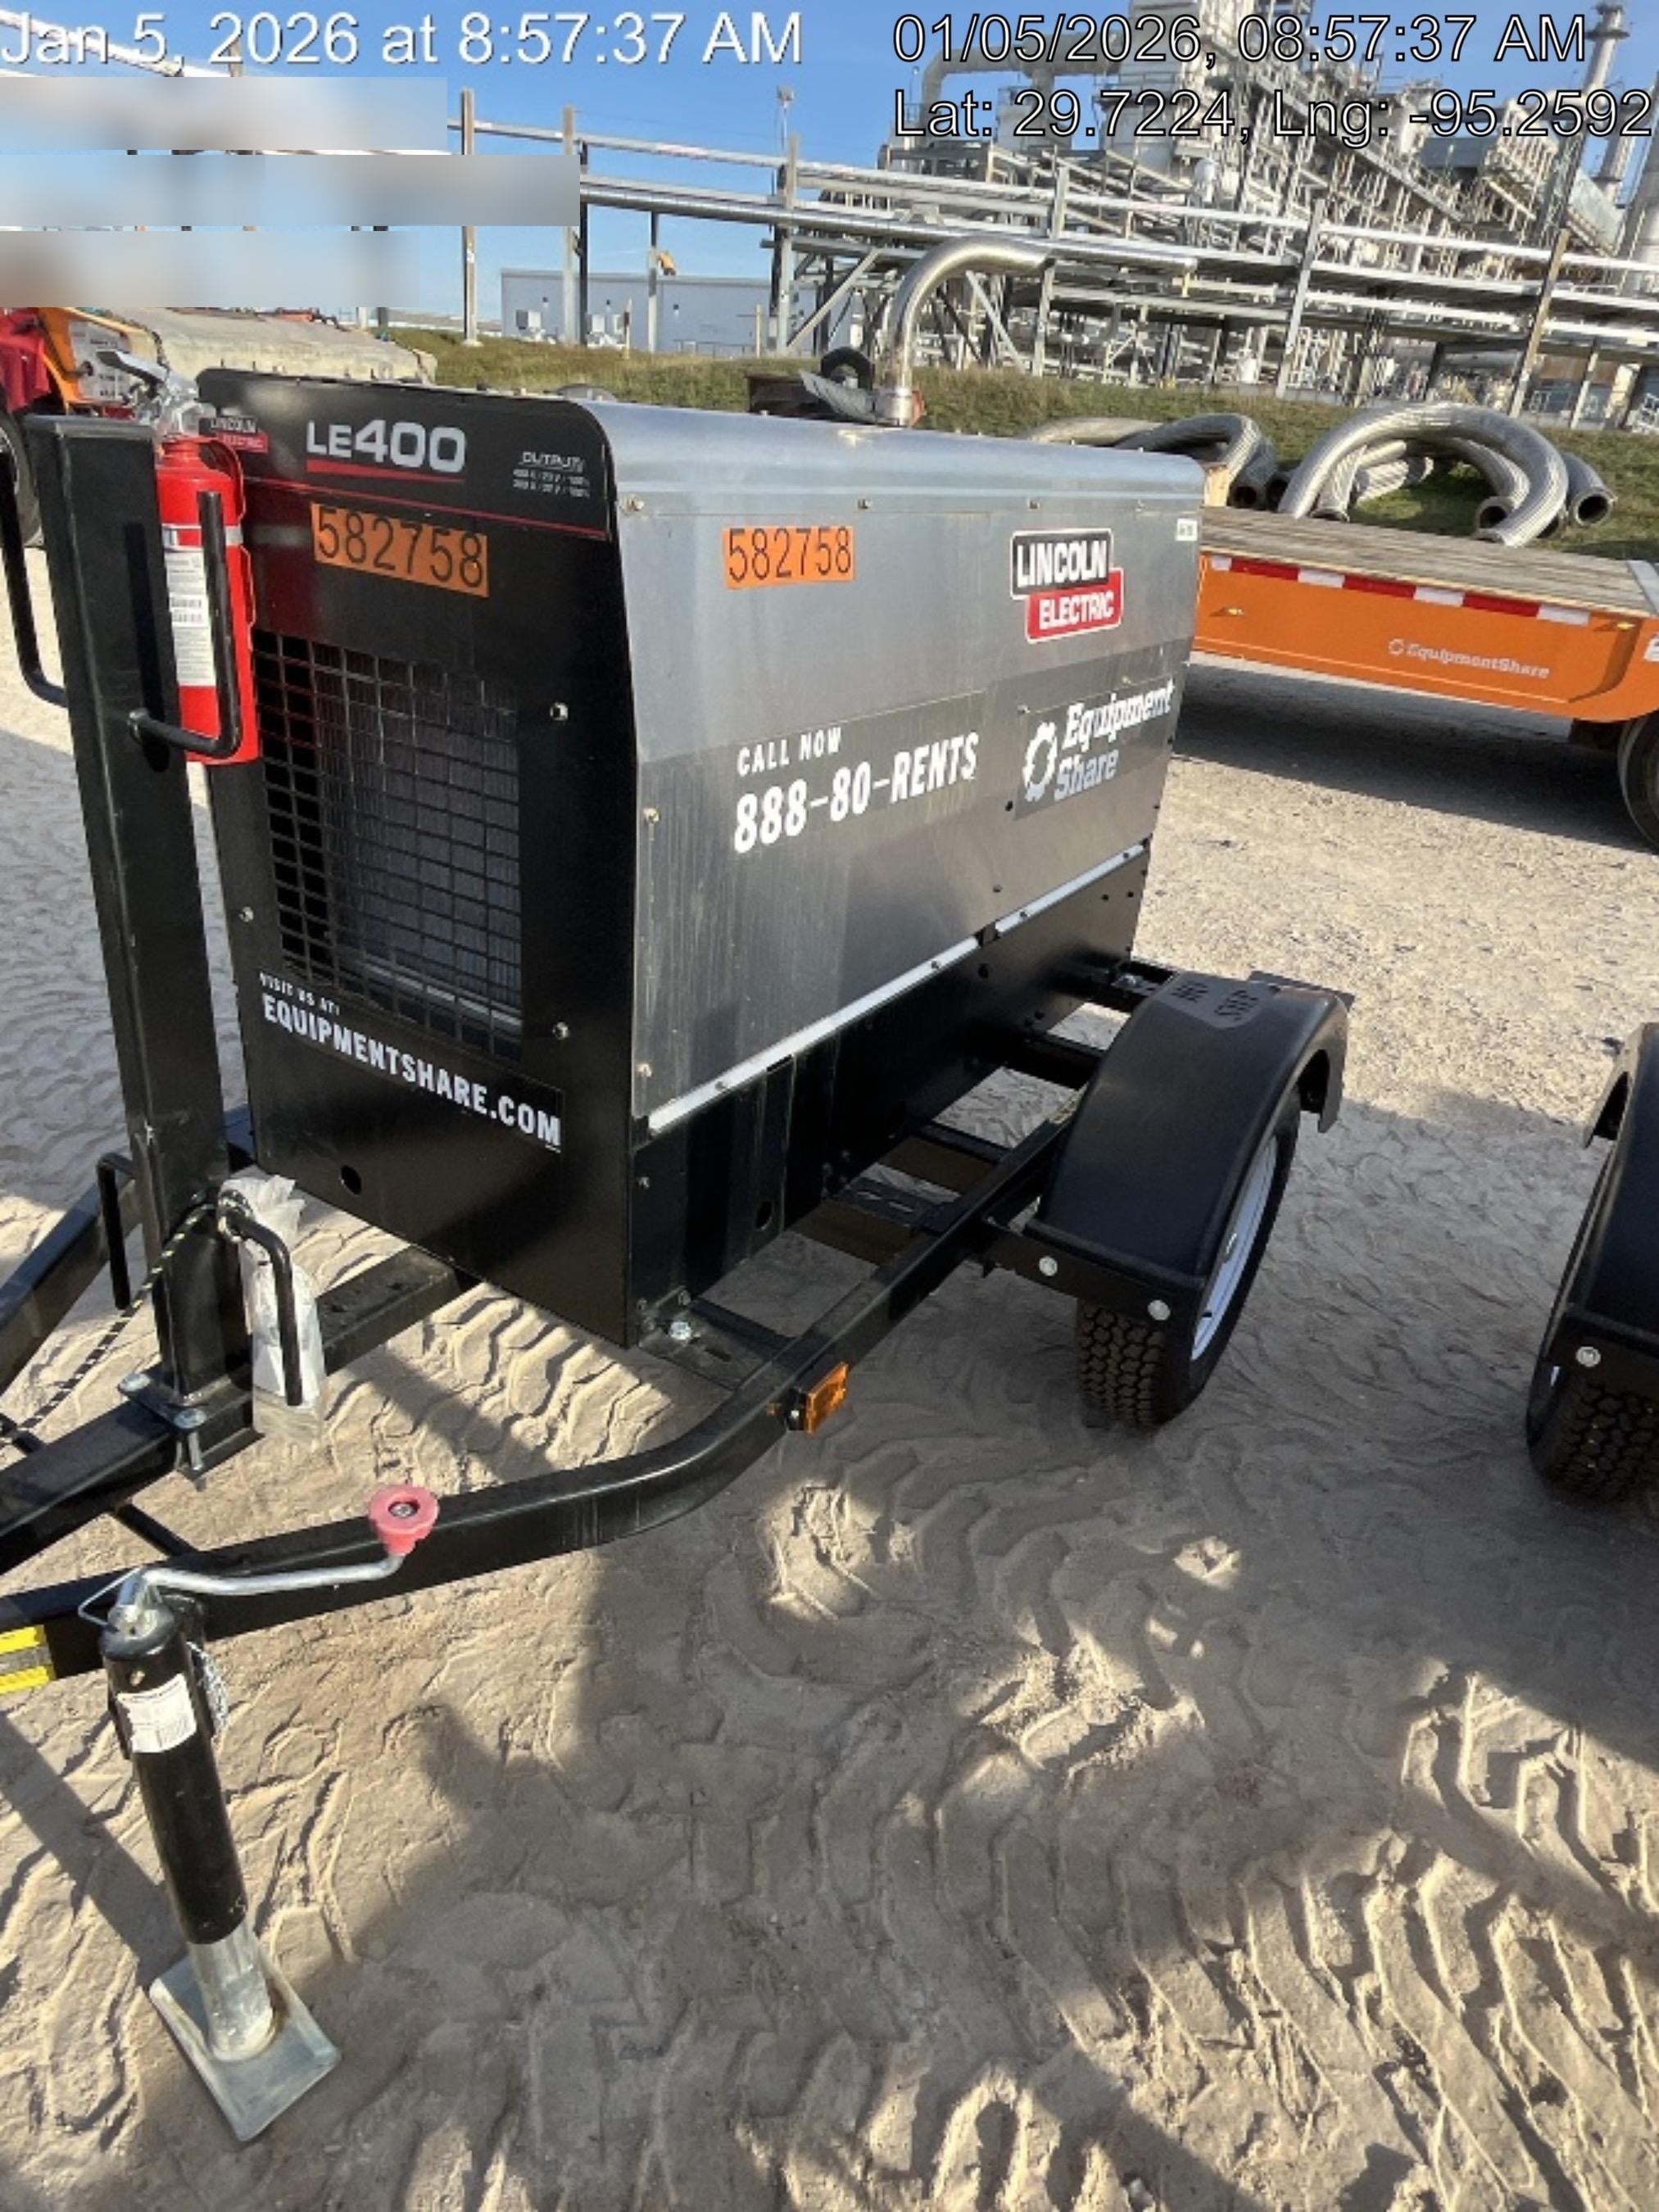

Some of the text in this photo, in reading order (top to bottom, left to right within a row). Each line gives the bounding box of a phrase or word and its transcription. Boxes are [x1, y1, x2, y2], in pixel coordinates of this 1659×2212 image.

[306, 419, 466, 473] LE400
[318, 506, 483, 588] 582758
[728, 526, 852, 582] 582758
[1016, 539, 1108, 588] LINCOLN
[1038, 590, 1115, 630] ELECTRIC
[1407, 642, 1550, 679] EquipmentShare
[1062, 678, 1175, 752] Equipment
[737, 727, 842, 777] CALL NOW
[1054, 749, 1120, 802] Share
[733, 732, 980, 853] 888-80-RENTS
[262, 993, 561, 1145] EQUIPMENTSHARE.COM
